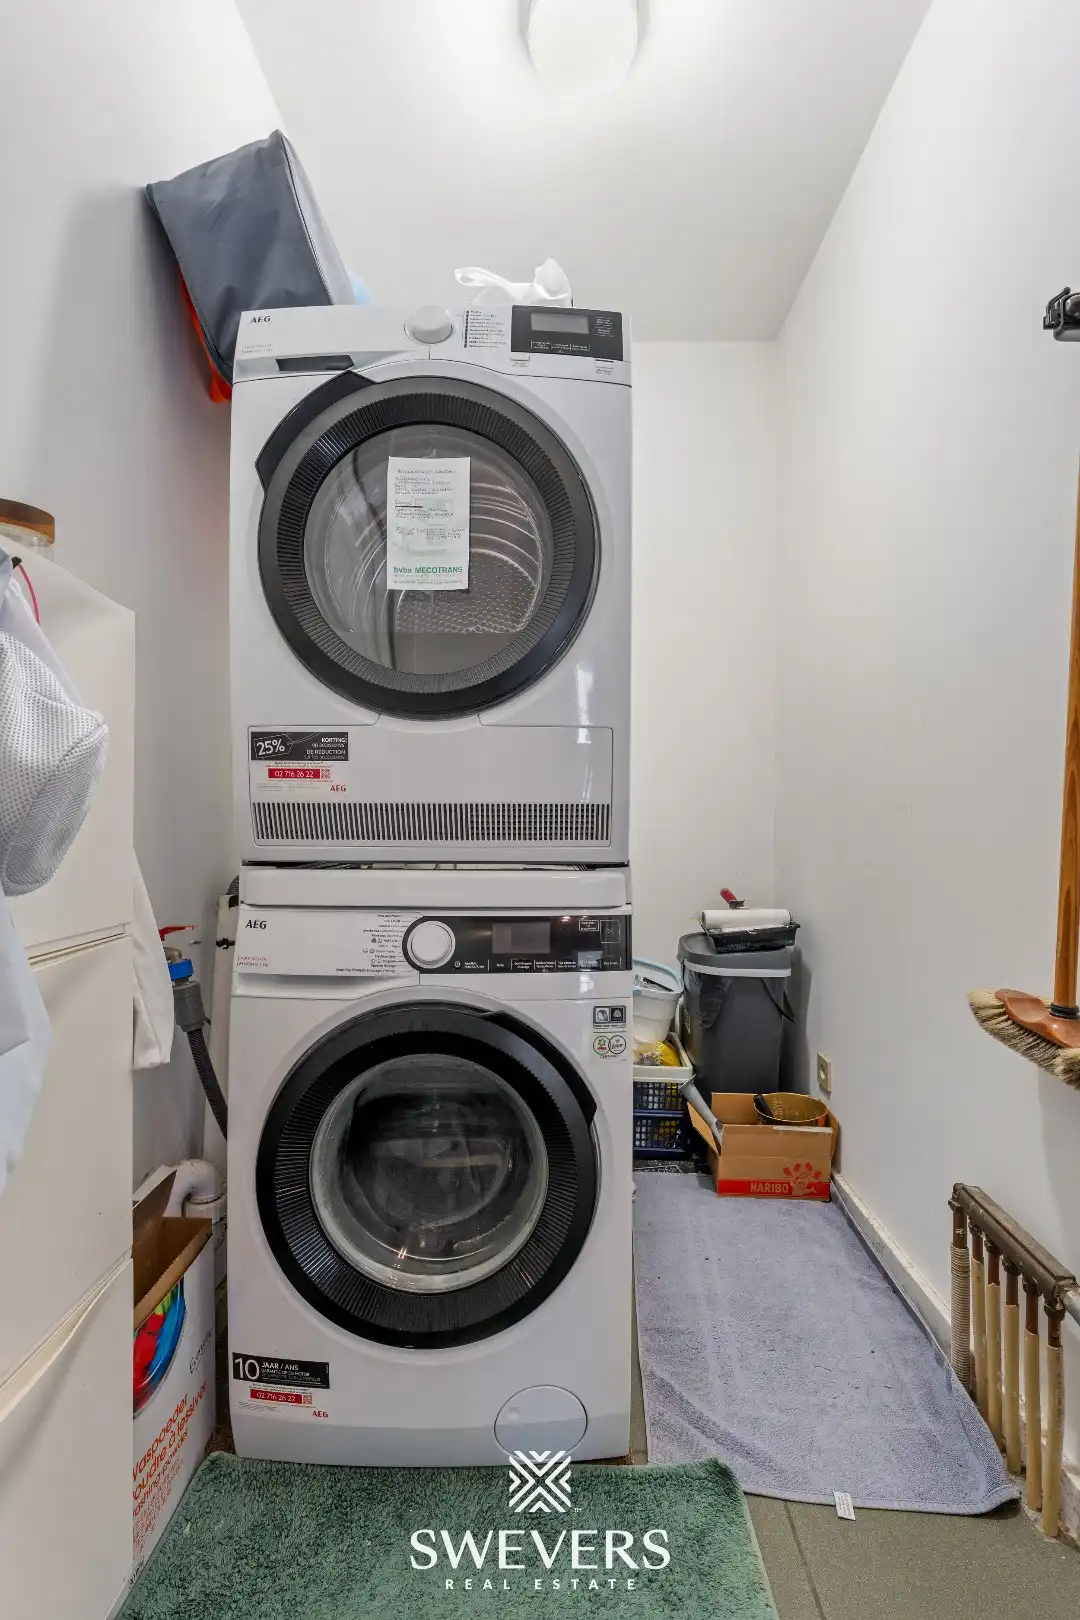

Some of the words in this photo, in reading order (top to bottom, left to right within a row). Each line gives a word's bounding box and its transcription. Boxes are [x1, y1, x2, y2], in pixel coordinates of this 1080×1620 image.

[256, 738, 285, 756] 25%
[246, 920, 267, 929] AEG
[750, 1182, 788, 1193] HARIBO
[234, 1358, 260, 1380] 10
[132, 1446, 166, 1500] oudre
